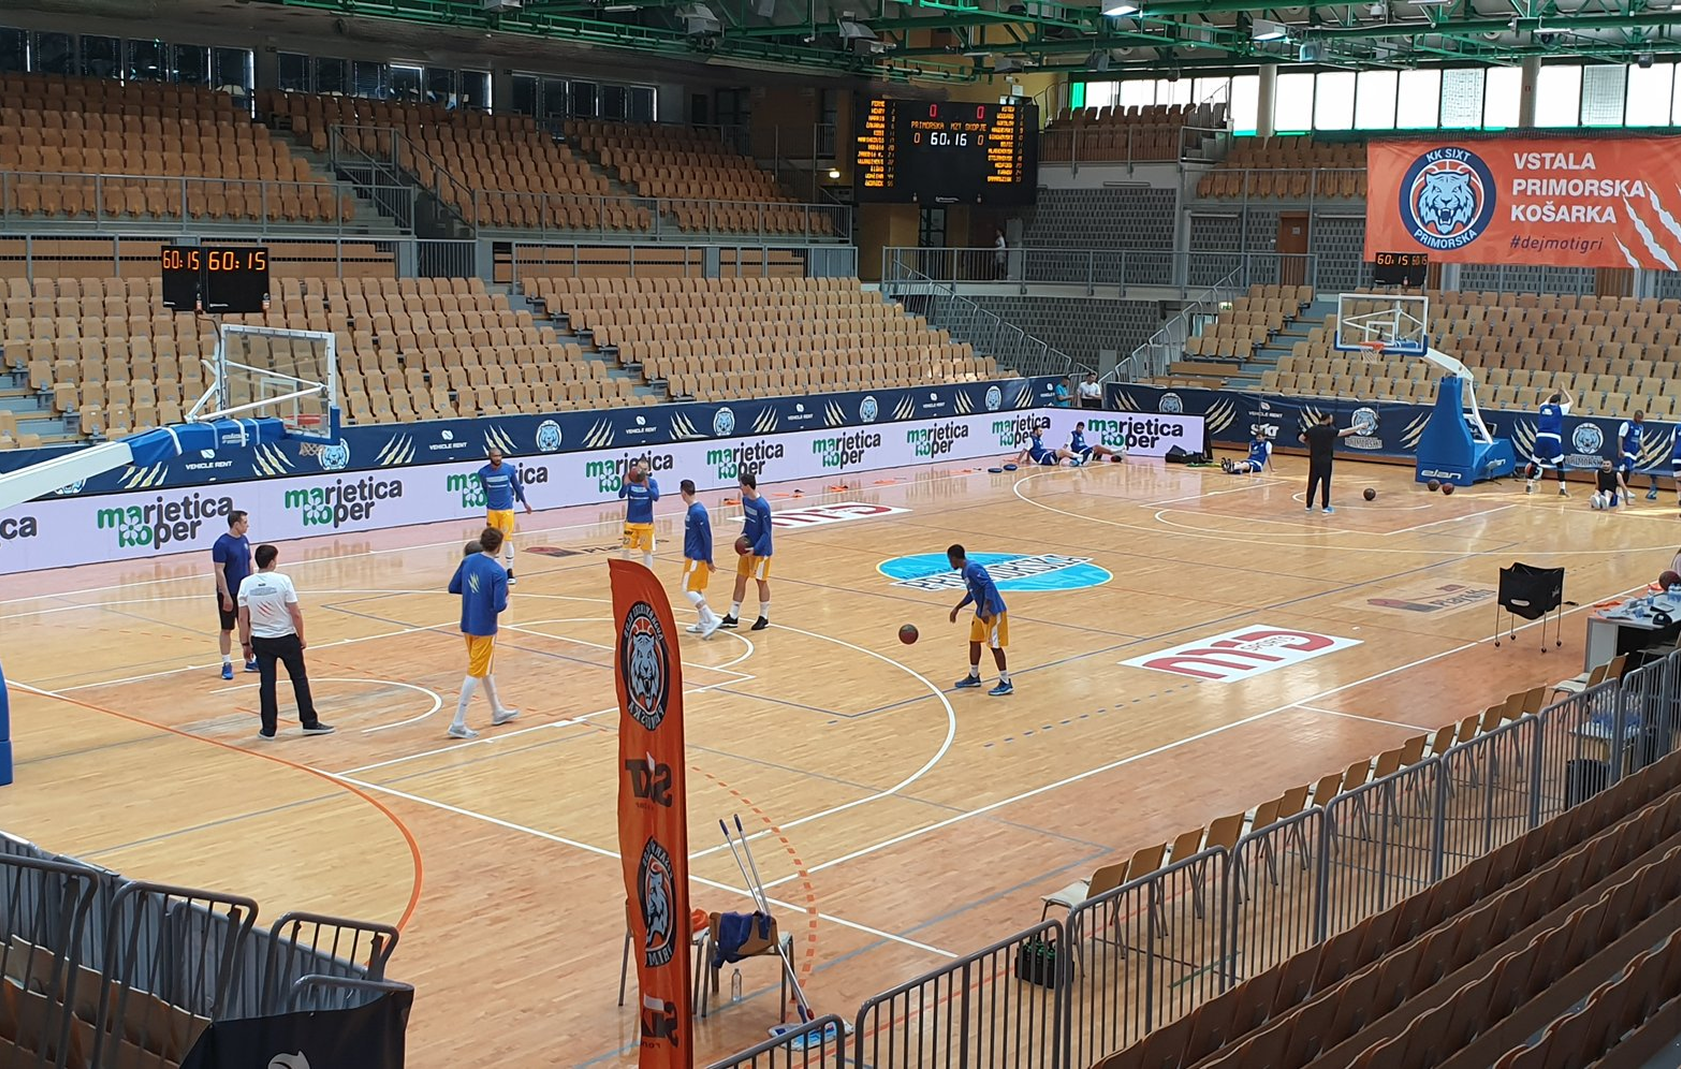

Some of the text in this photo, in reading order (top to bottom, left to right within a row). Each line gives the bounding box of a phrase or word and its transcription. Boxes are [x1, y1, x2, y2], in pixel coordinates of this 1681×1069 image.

[929, 104, 937, 118] 0
[976, 106, 985, 119] 0
[910, 121, 944, 130] PRIMORSKA
[913, 132, 921, 144] 0
[977, 134, 985, 146] 0
[1426, 148, 1471, 163] KK SIXT
[1513, 152, 1596, 170] VSTALA
[1512, 178, 1646, 198] PRIMORSKA
[1510, 200, 1617, 224] KOŠARKA
[1413, 228, 1478, 249] PRIMORSKA
[1509, 235, 1604, 254] #dejmotigri
[163, 250, 200, 270] 60:15
[208, 251, 266, 271] 60:15
[907, 421, 969, 444] marjetica
[1088, 416, 1184, 438] marjetica
[812, 430, 881, 454] marjetica
[915, 439, 954, 459] koper
[1101, 432, 1160, 451] koper
[707, 440, 784, 465] marjetica
[822, 448, 865, 470] koper
[185, 460, 233, 471] VEHICLE RENT
[1421, 469, 1462, 480] elan
[284, 475, 403, 509] marjetica
[97, 492, 233, 529] marjetica
[303, 500, 376, 529] koper
[118, 519, 203, 550] koper
[1241, 633, 1297, 652] SPORTS
